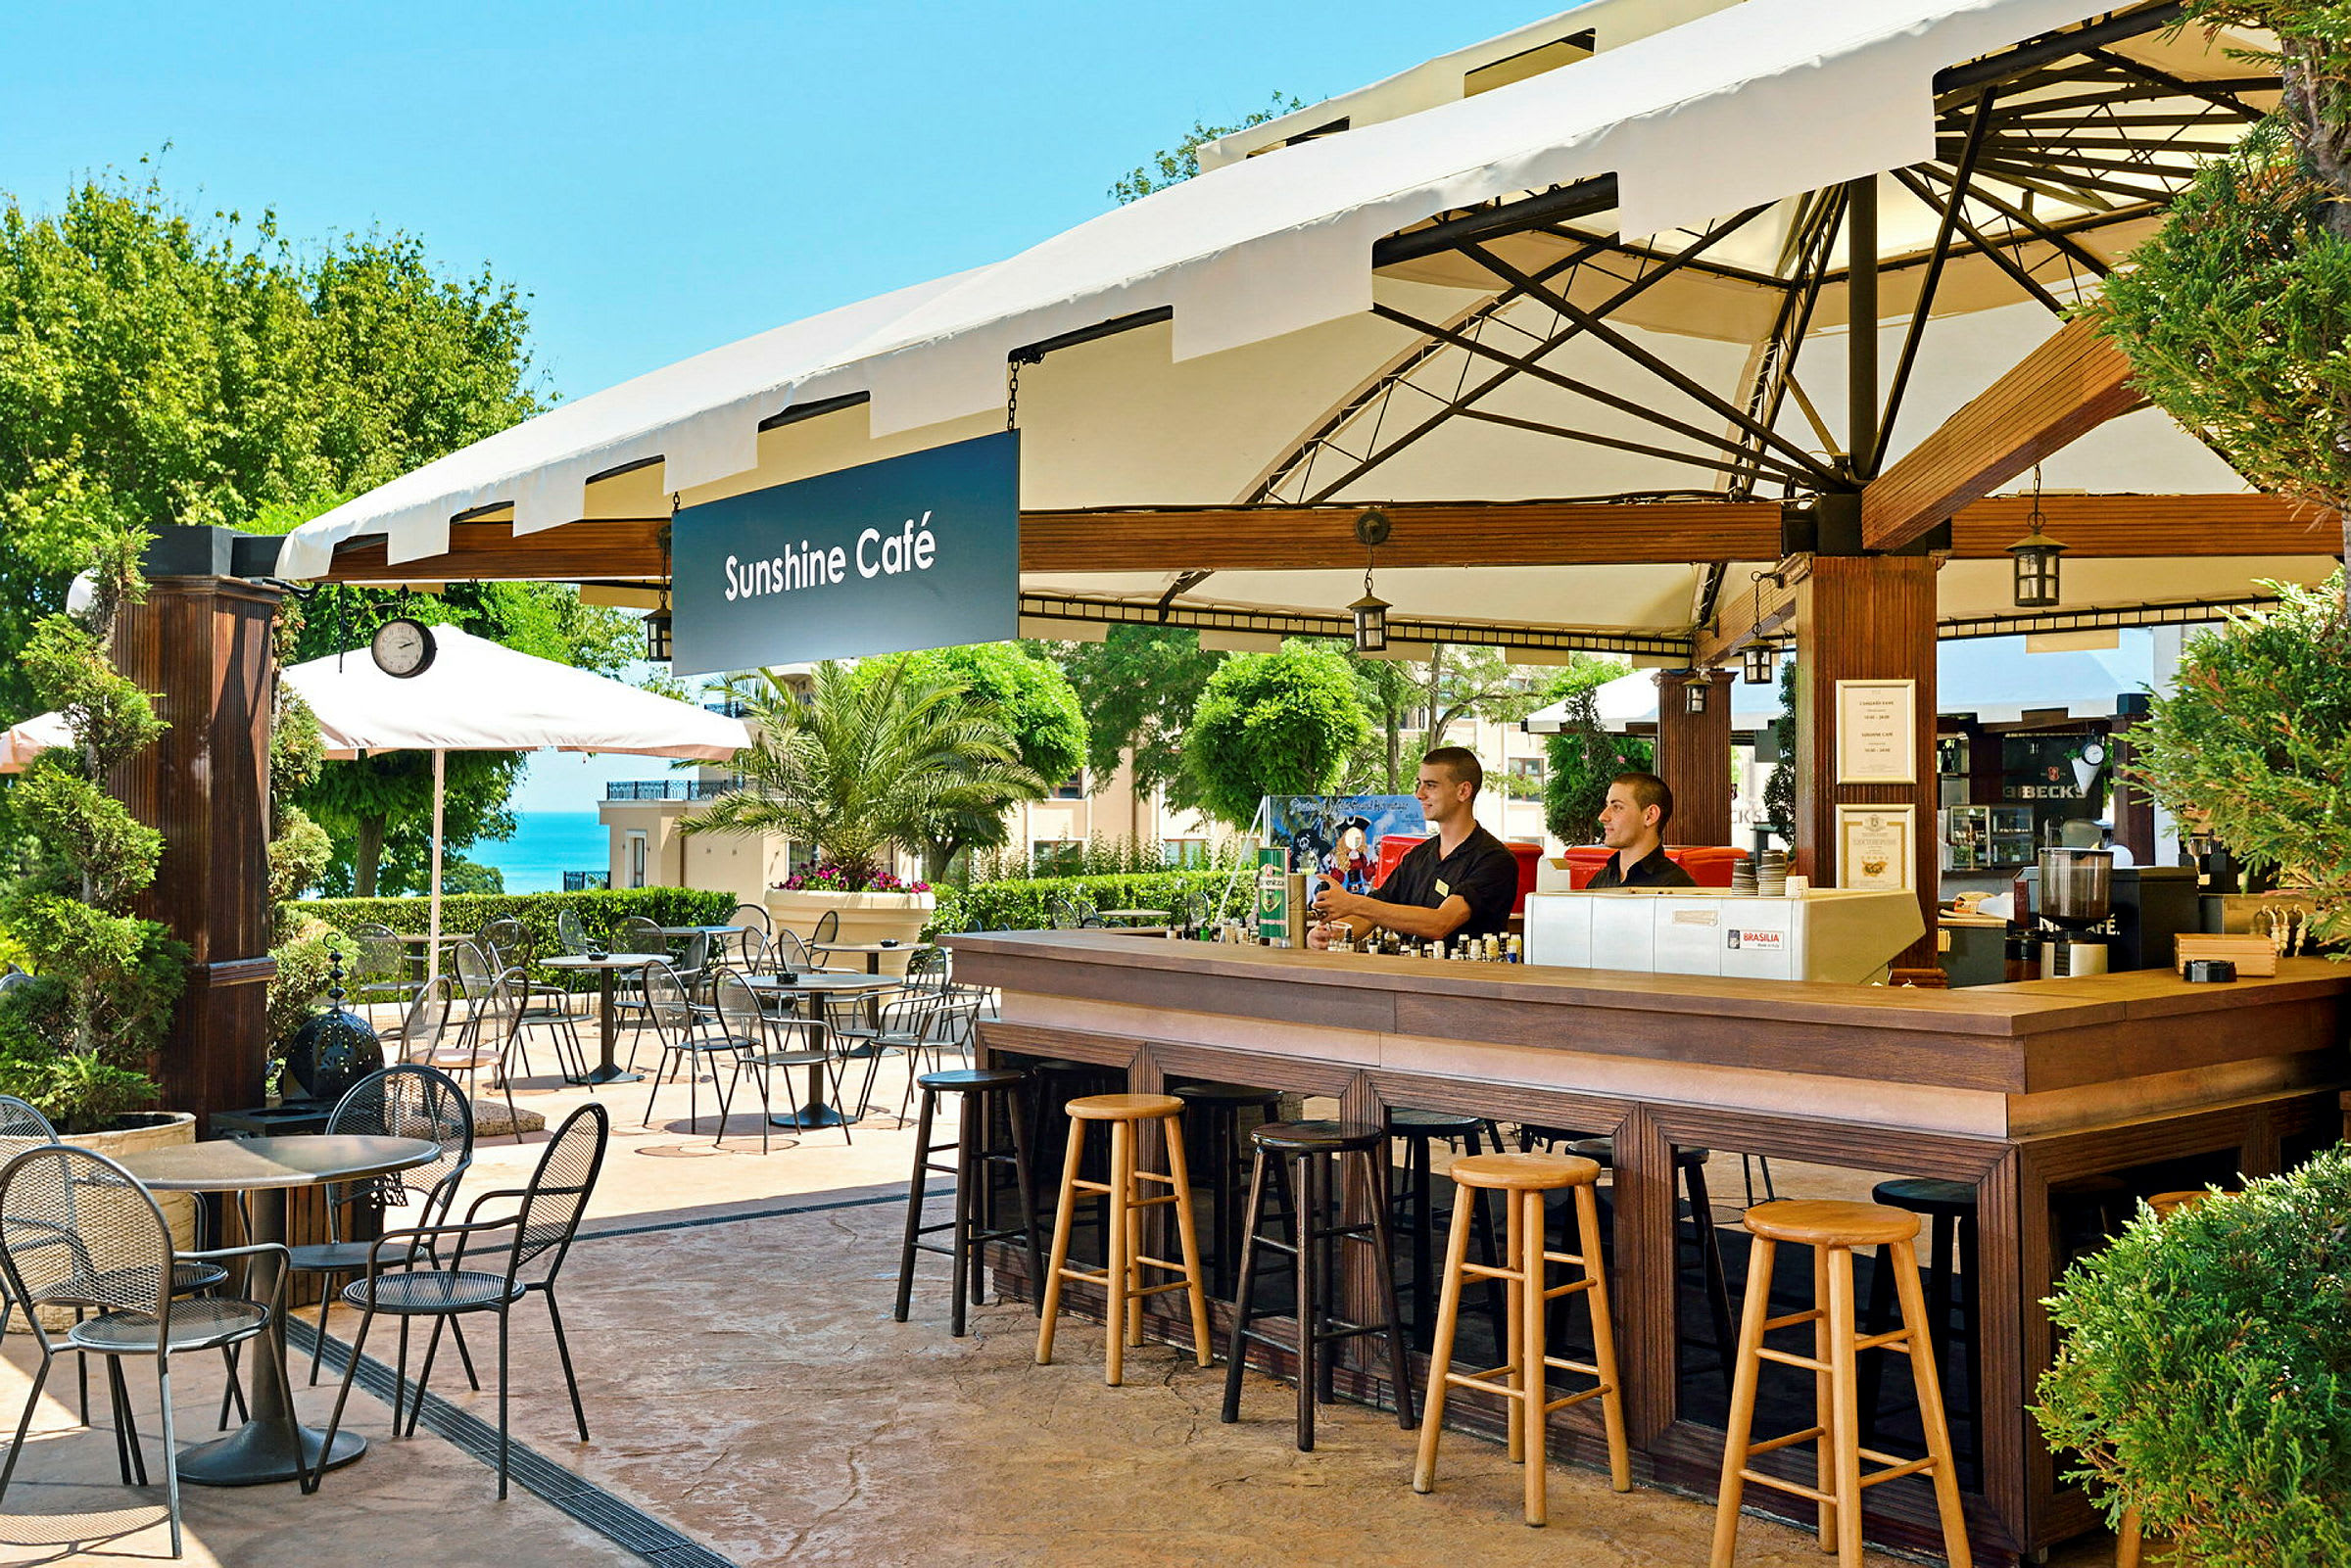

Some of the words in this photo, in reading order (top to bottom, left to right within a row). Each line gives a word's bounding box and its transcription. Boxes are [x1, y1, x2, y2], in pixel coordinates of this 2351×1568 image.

[725, 540, 846, 601] Sunshine
[856, 510, 936, 579] Café
[1743, 932, 1780, 943] BRASILIA
